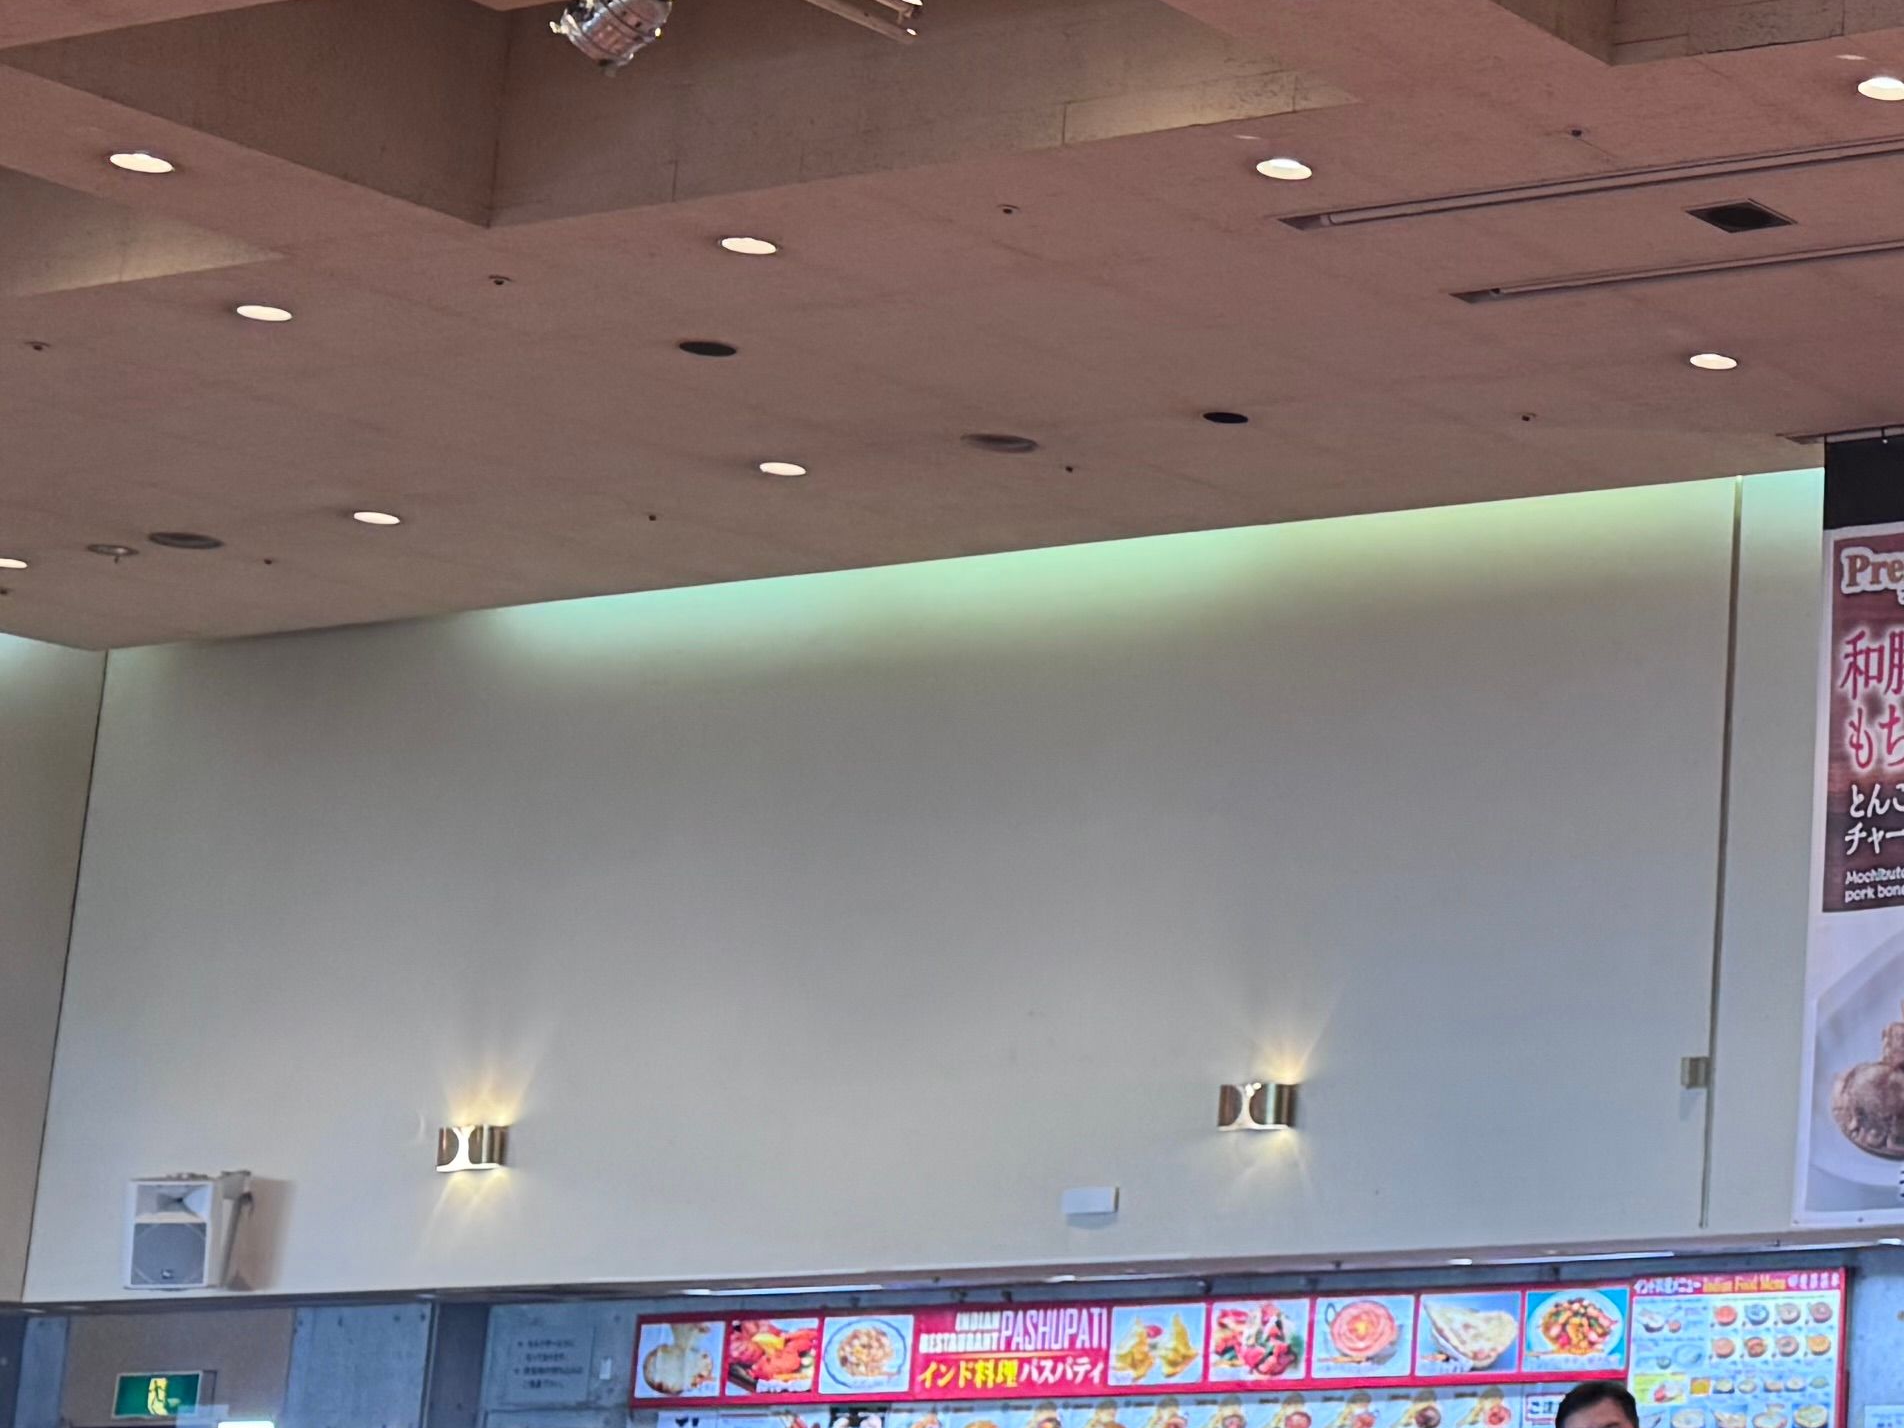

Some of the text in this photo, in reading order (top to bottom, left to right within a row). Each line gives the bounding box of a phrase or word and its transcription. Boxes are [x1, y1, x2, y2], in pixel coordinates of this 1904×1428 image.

[1845, 886, 1875, 904] pork
[1000, 1308, 1108, 1350] PASHUPATI
[918, 1356, 1104, 1388] インド料理 パスパティ
